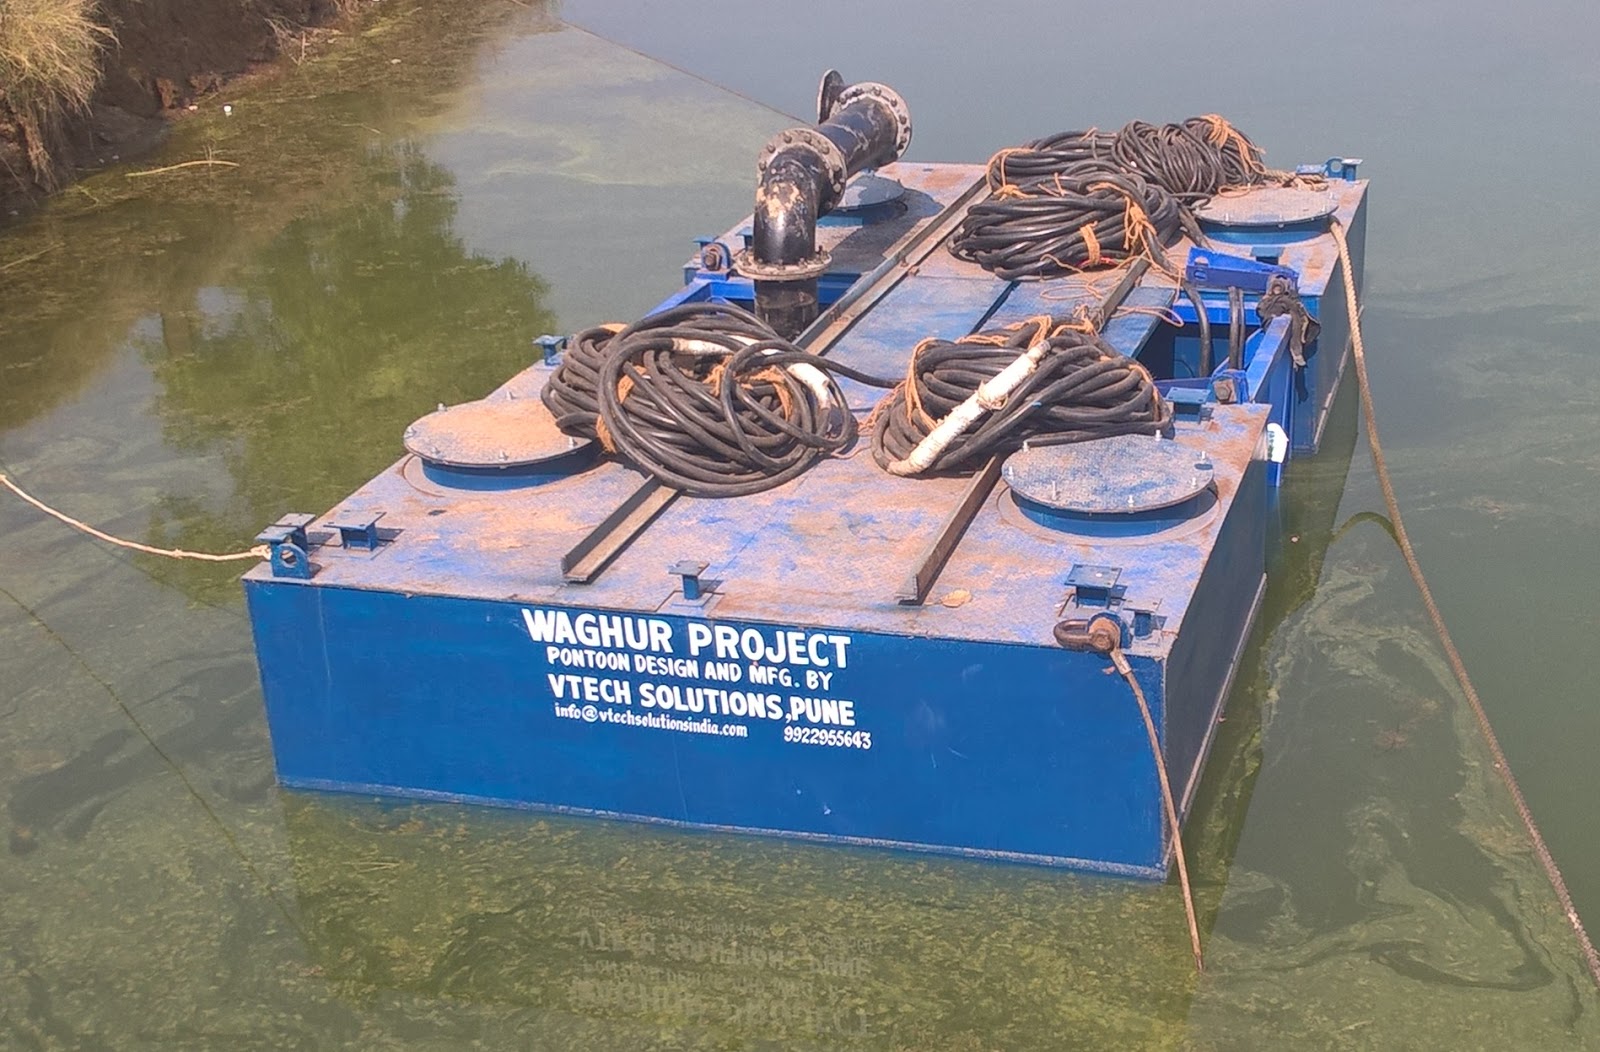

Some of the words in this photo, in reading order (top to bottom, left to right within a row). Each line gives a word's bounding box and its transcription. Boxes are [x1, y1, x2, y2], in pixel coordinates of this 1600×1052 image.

[522, 608, 673, 653] WAGHUR
[688, 623, 851, 668] PROJECT
[546, 646, 630, 672] PONTOON
[634, 658, 699, 679] DESIGN
[704, 666, 742, 683] AND
[749, 665, 800, 688] MFG.
[806, 671, 833, 691] BY
[548, 674, 631, 705] VTECH
[554, 703, 748, 737] info@vtechsolutionsindia.com
[784, 726, 872, 749] 9922955643
